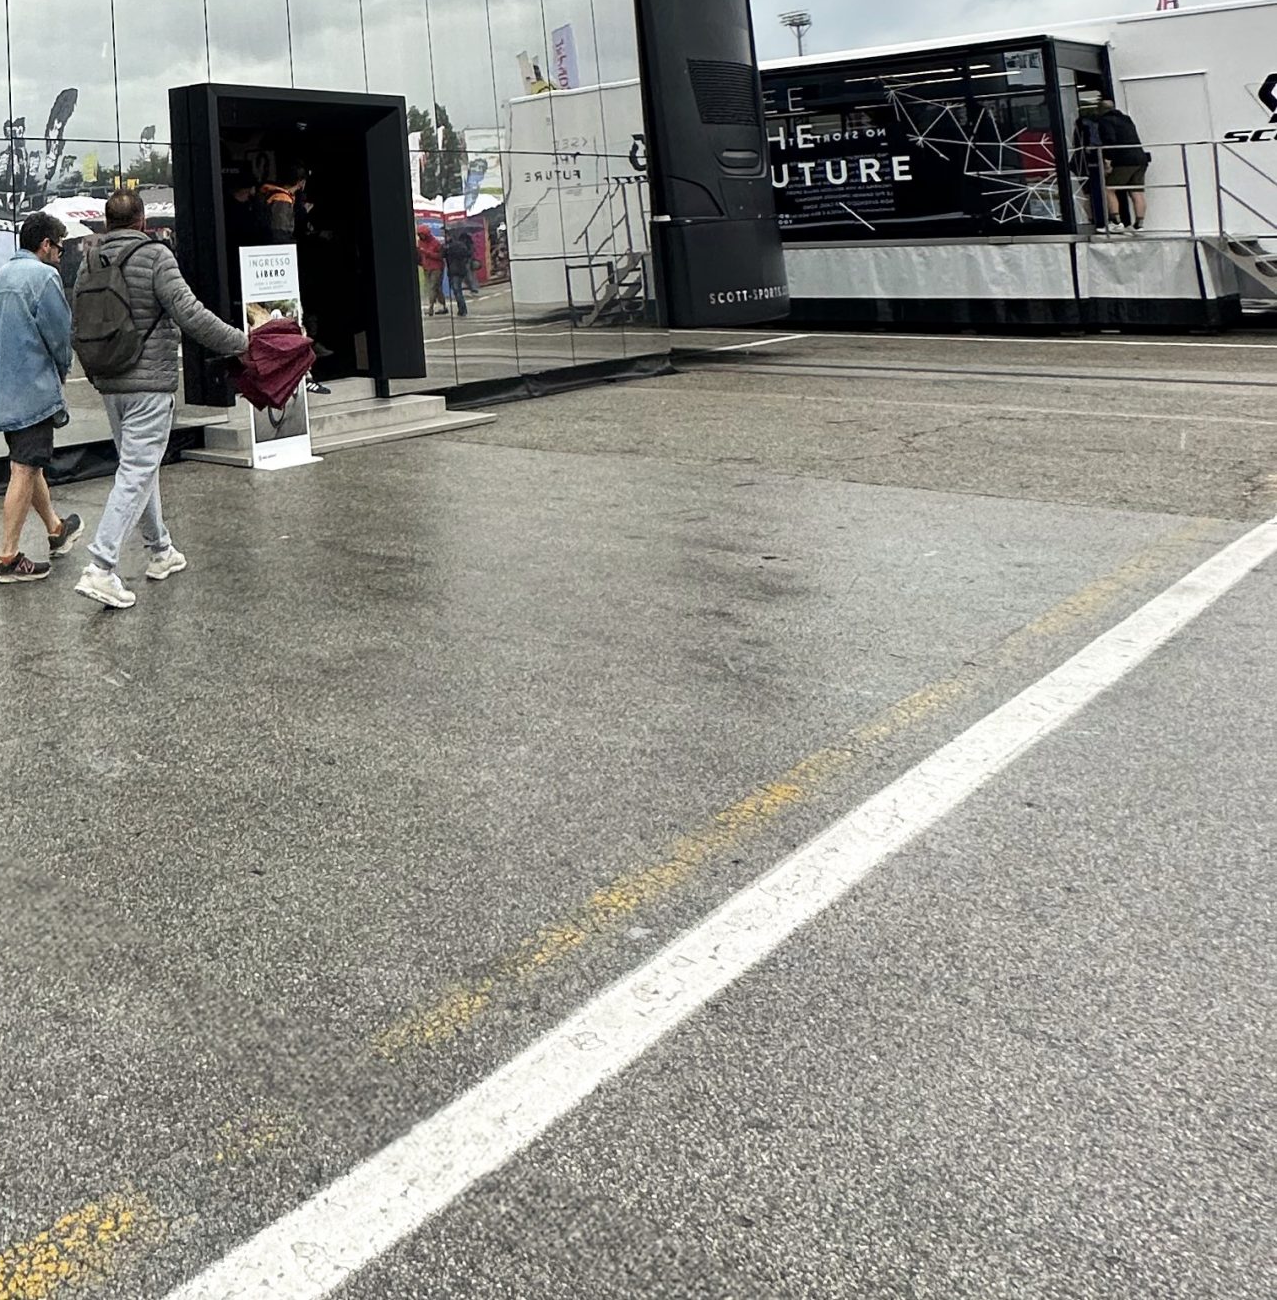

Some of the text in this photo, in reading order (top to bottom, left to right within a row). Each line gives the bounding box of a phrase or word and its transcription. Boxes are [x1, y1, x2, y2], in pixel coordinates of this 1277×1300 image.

[1222, 128, 1277, 144] SC
[249, 257, 291, 268] INGRESSO
[256, 268, 286, 279] LIBERO
